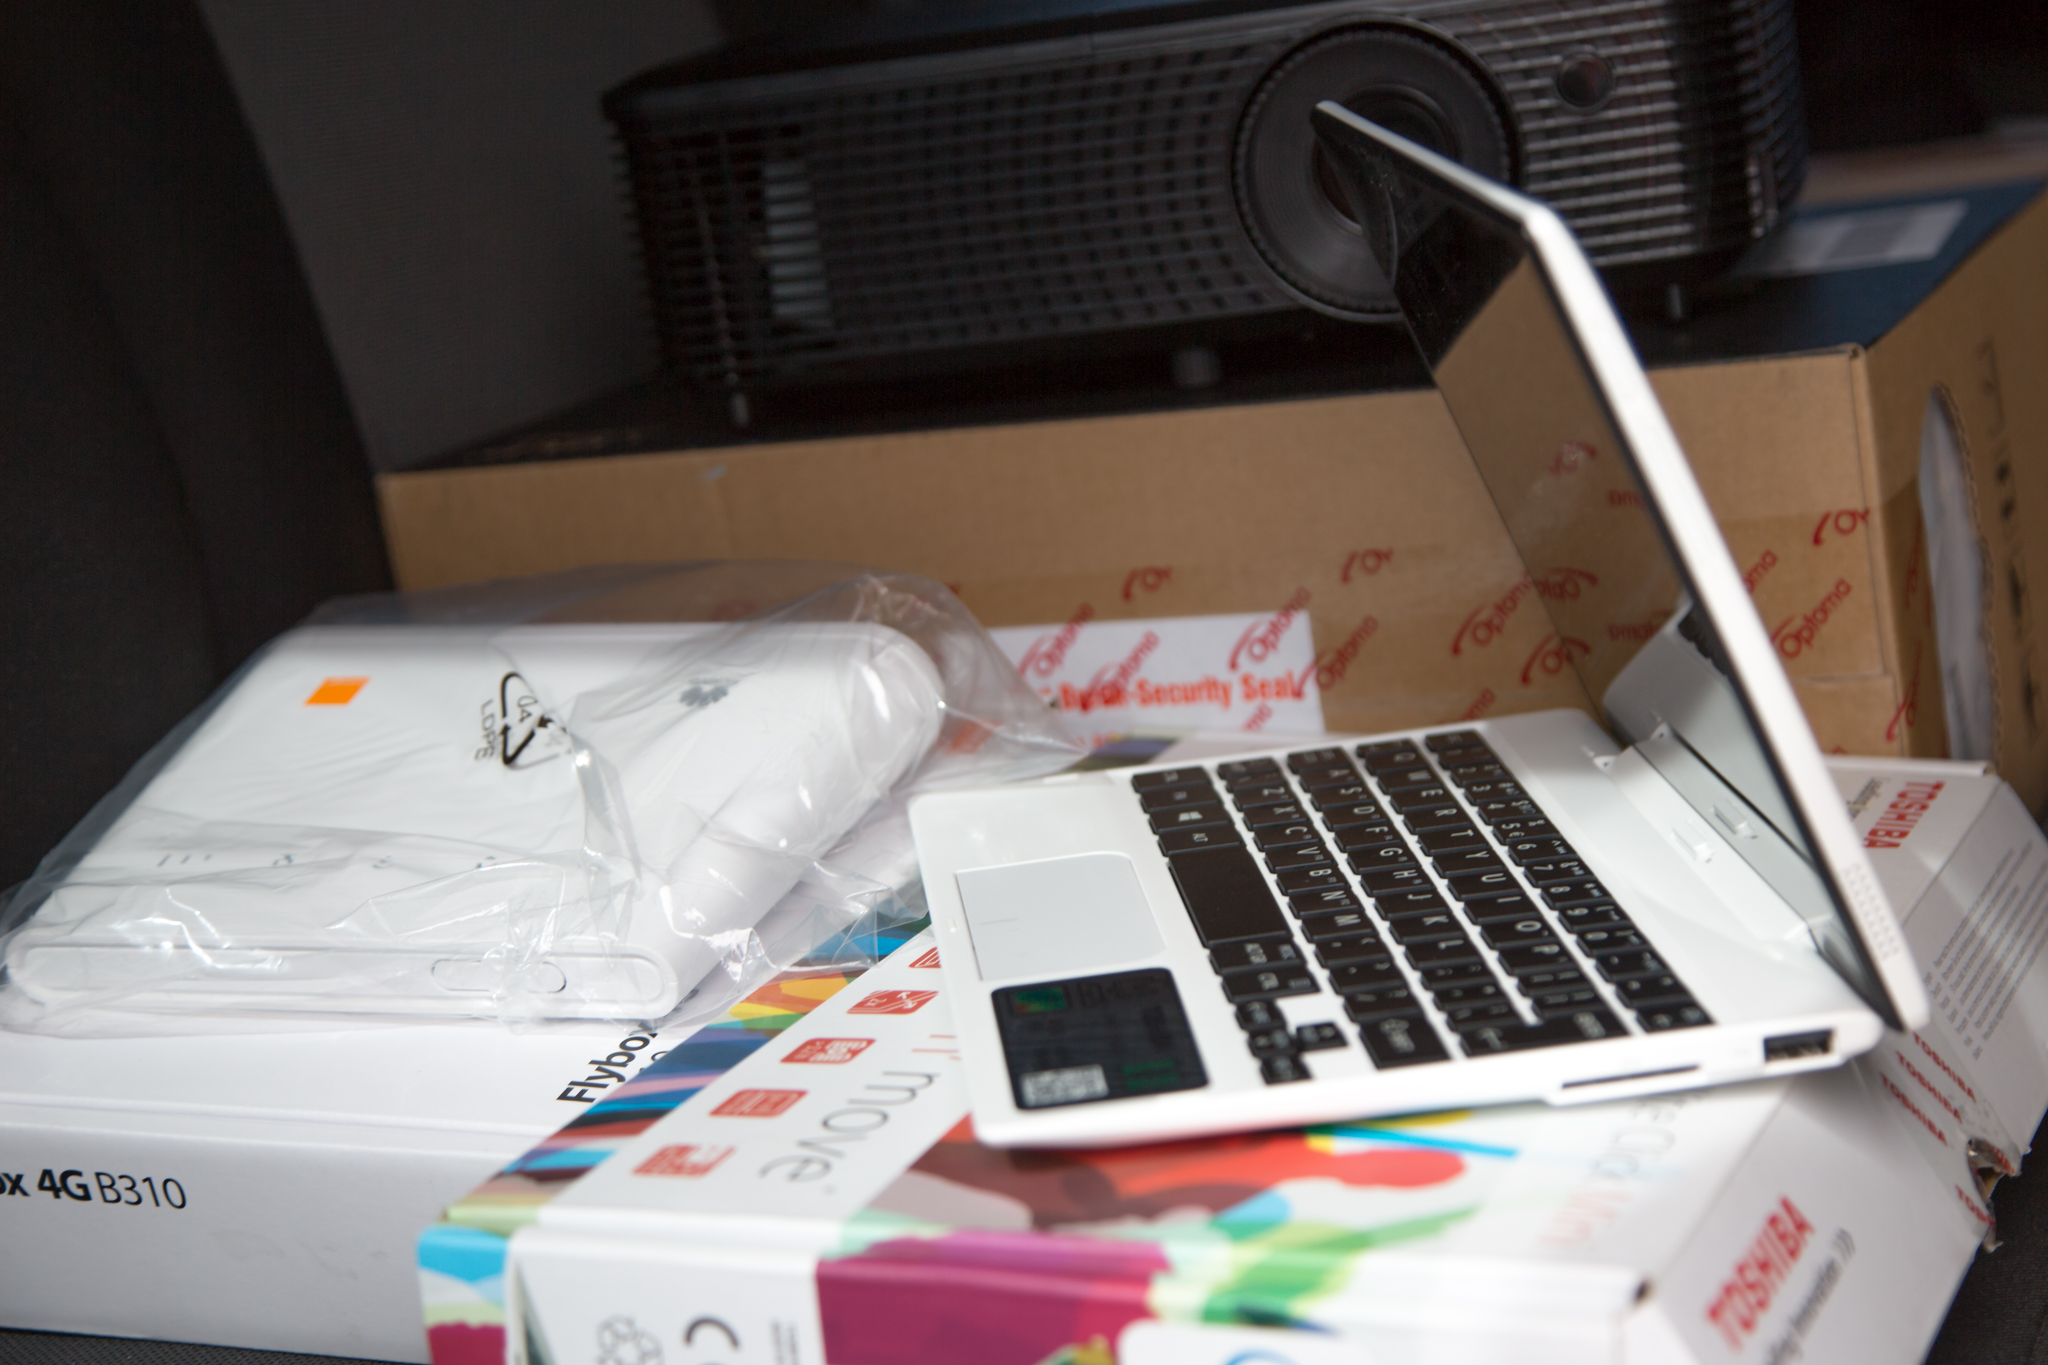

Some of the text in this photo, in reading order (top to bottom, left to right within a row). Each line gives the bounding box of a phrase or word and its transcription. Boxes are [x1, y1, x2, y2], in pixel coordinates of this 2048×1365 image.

[1772, 578, 1853, 660] Optoma
[1261, 787, 1362, 927] Z X C V B N M
[1339, 787, 1363, 796] S
[1353, 805, 1376, 815] D
[1365, 826, 1389, 834] F
[1379, 847, 1403, 858] G
[1392, 869, 1419, 880] H
[1422, 915, 1450, 927] K
[1421, 788, 1444, 798] E
[1435, 808, 1458, 818] R
[1450, 829, 1475, 838] T
[1465, 851, 1490, 860] Y
[1481, 873, 1507, 883] U
[1862, 780, 1947, 849] TOSHIBA
[1501, 822, 1522, 831] 5
[1517, 843, 1537, 851] 6
[1549, 885, 1571, 894] 8
[1566, 907, 1590, 916] 9
[1879, 1070, 1949, 1147] TOSHIBA
[1895, 1049, 1963, 1125] TOSHIBA
[1912, 1030, 1978, 1104] TOSHIBA
[757, 1069, 943, 1183] move
[37, 1168, 93, 1202] 4G
[94, 1171, 188, 1210] B310
[1707, 1195, 1816, 1353] TOSHIBA
